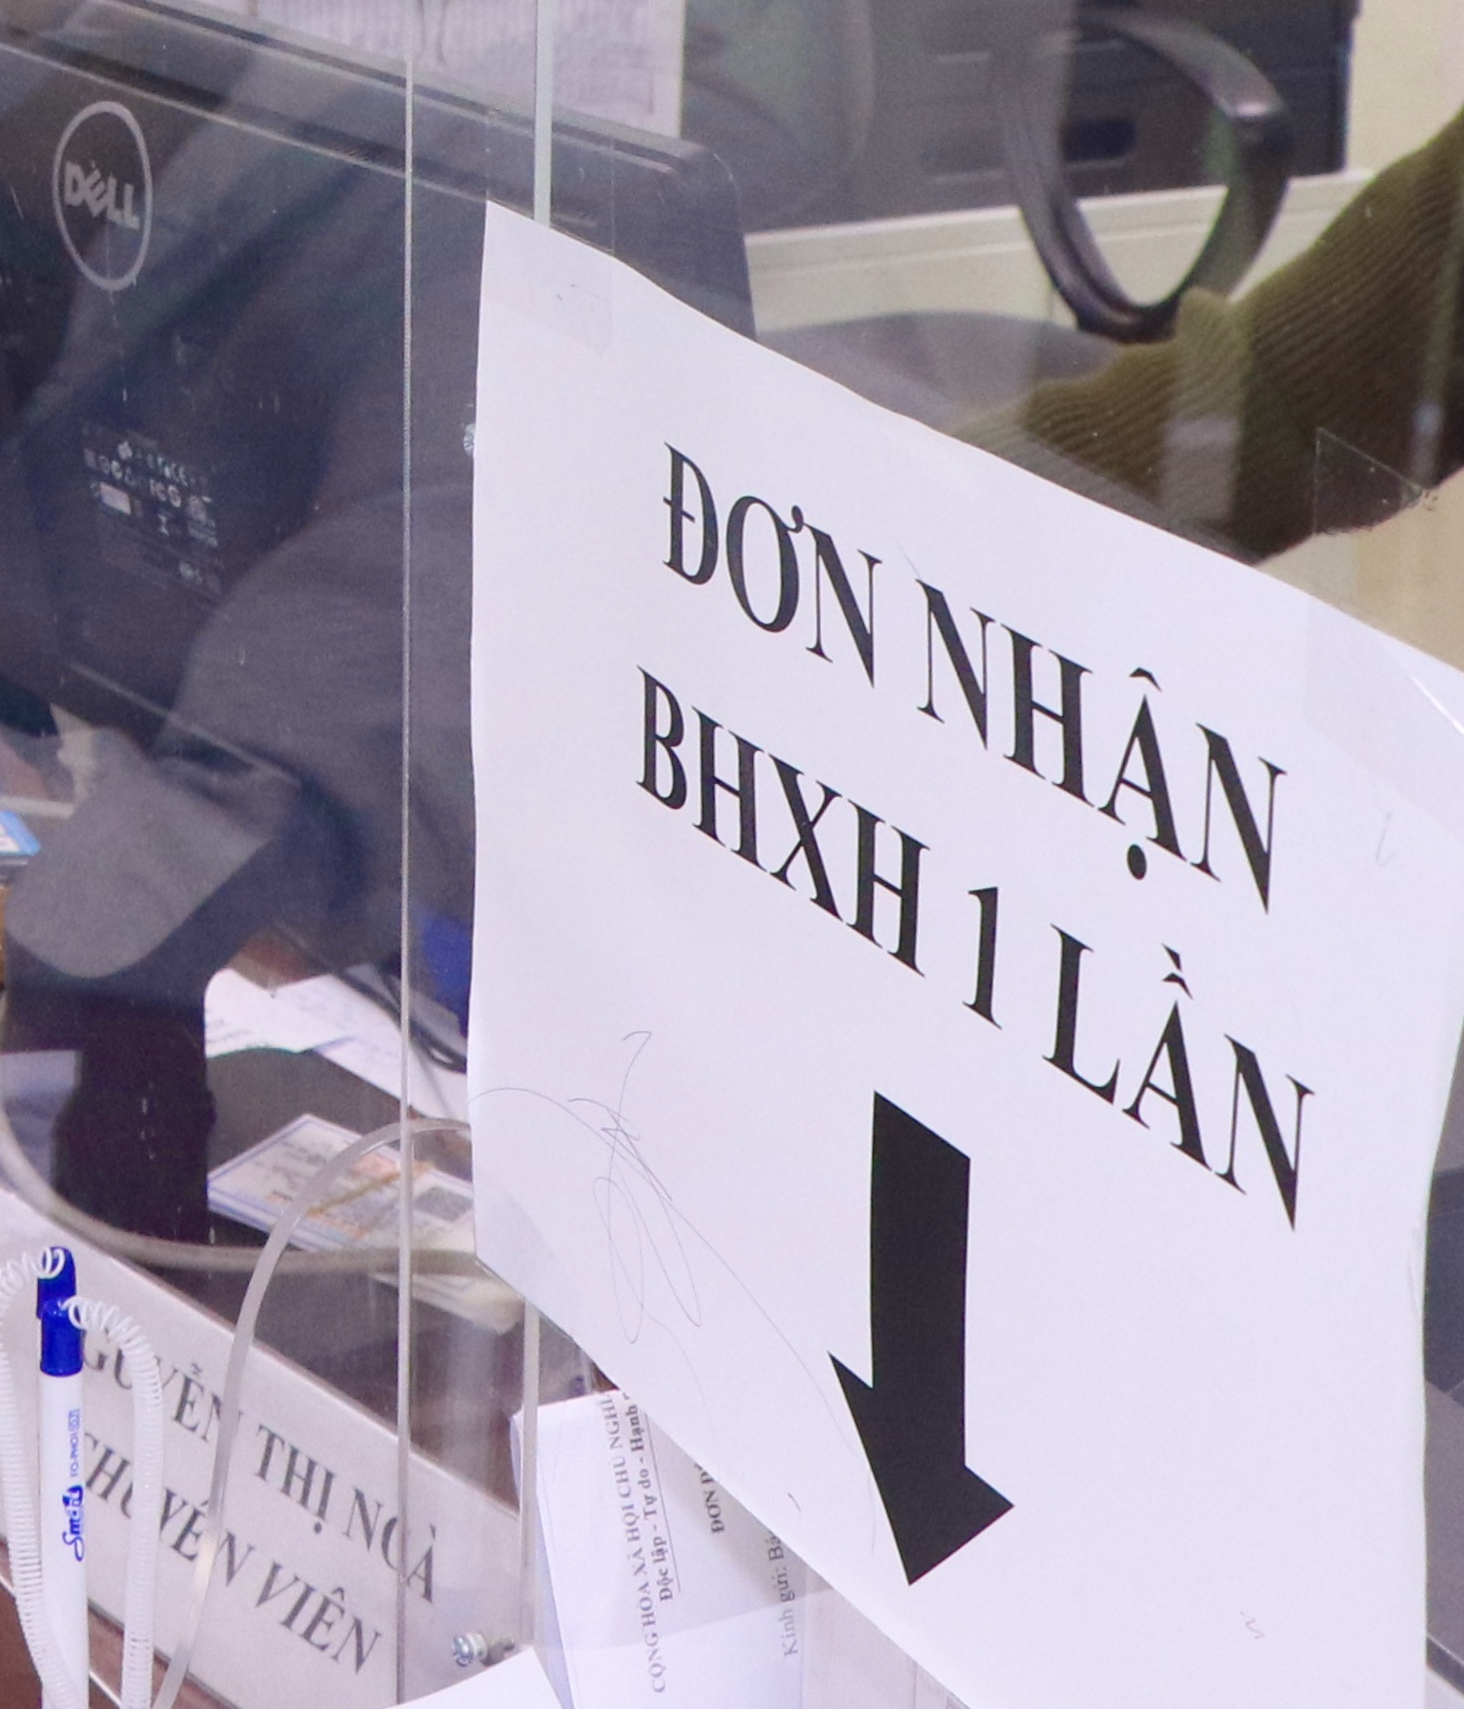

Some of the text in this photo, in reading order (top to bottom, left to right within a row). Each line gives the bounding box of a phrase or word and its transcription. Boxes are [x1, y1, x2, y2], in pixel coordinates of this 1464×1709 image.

[63, 159, 140, 231] DELL
[662, 441, 1286, 915] ĐƠN NHẬN
[636, 665, 1315, 1231] BHXH 1 LẦN
[254, 1424, 338, 1535] THỊ
[254, 1561, 383, 1676] VIÊN
